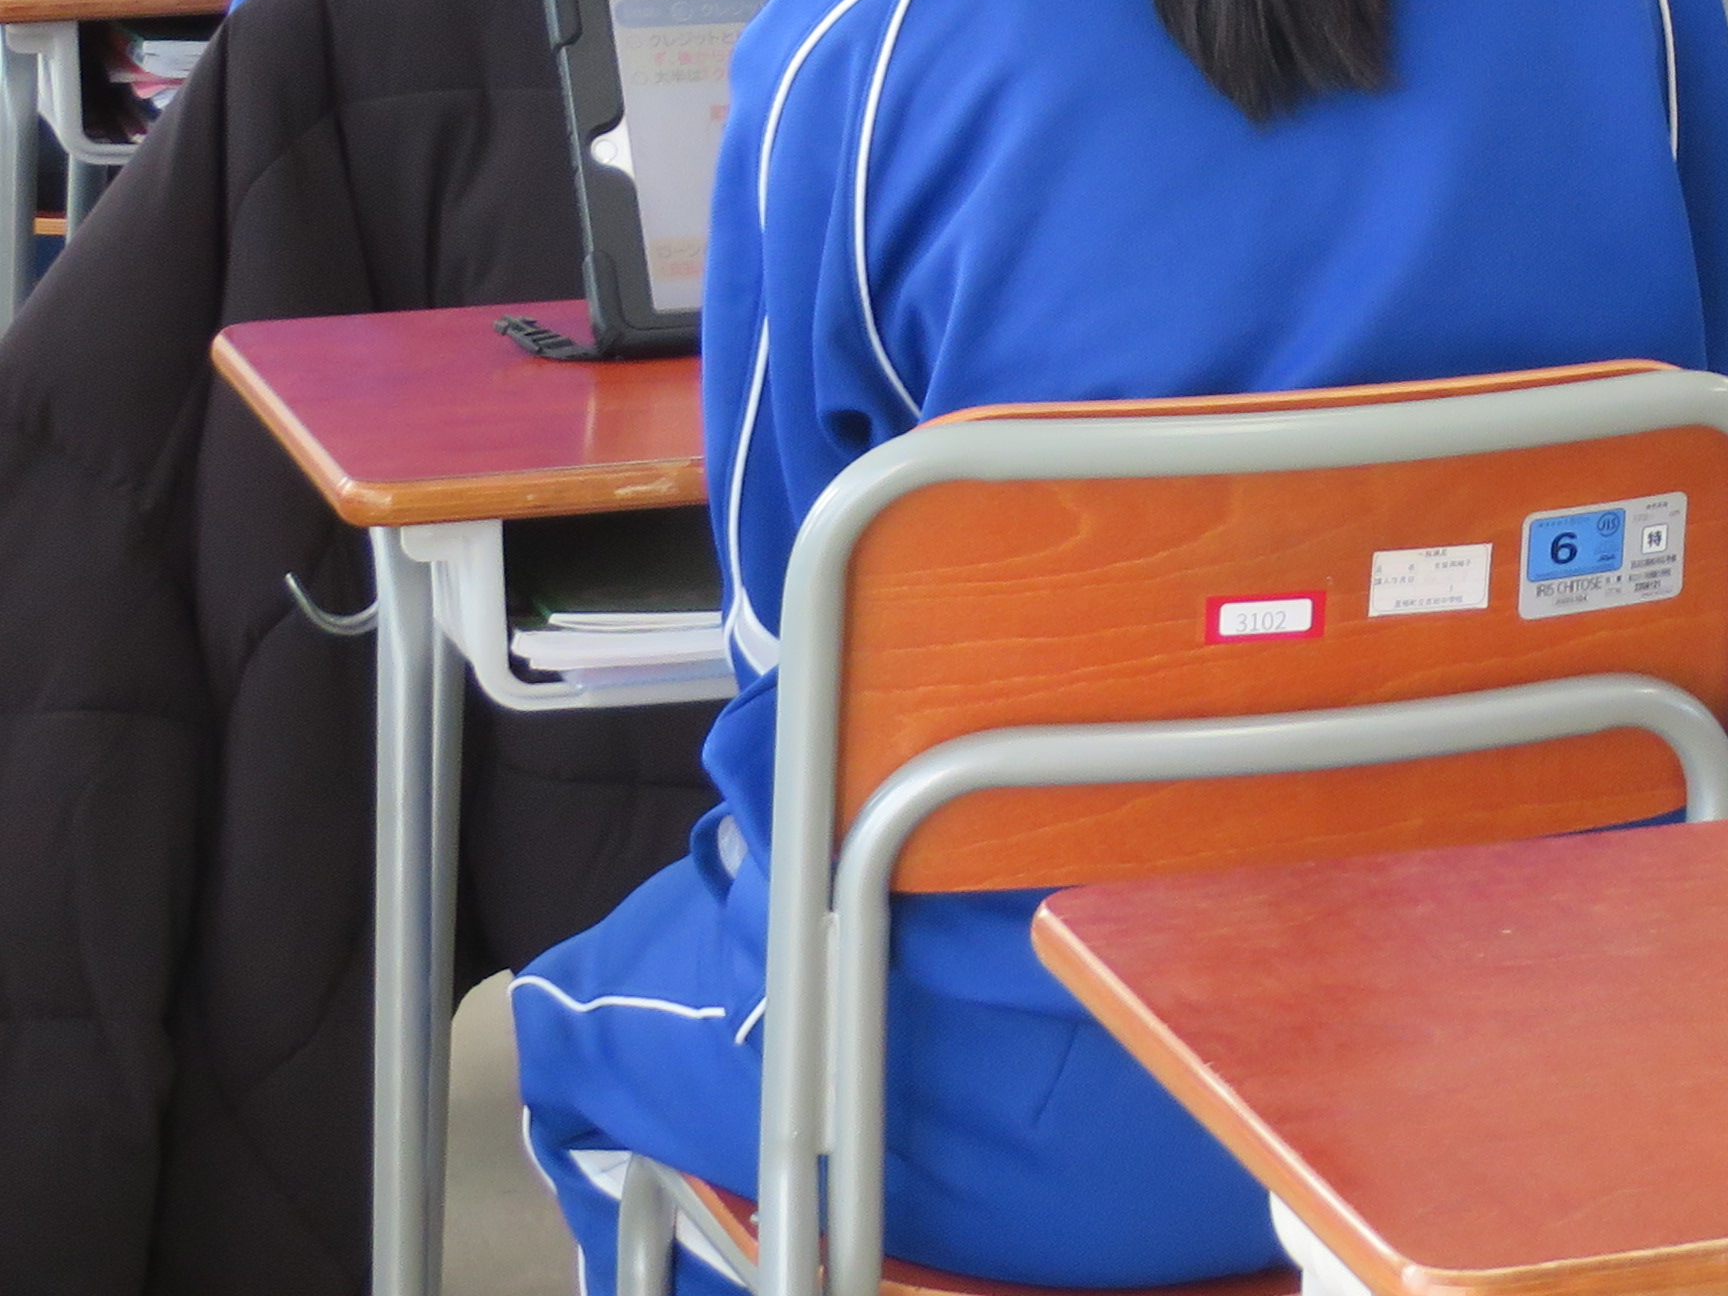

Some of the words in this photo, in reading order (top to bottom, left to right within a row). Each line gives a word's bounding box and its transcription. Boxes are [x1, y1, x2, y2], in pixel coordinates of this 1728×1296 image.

[1550, 532, 1578, 565] 6
[1557, 577, 1603, 596] CHITOSE
[1235, 611, 1288, 633] 3102
